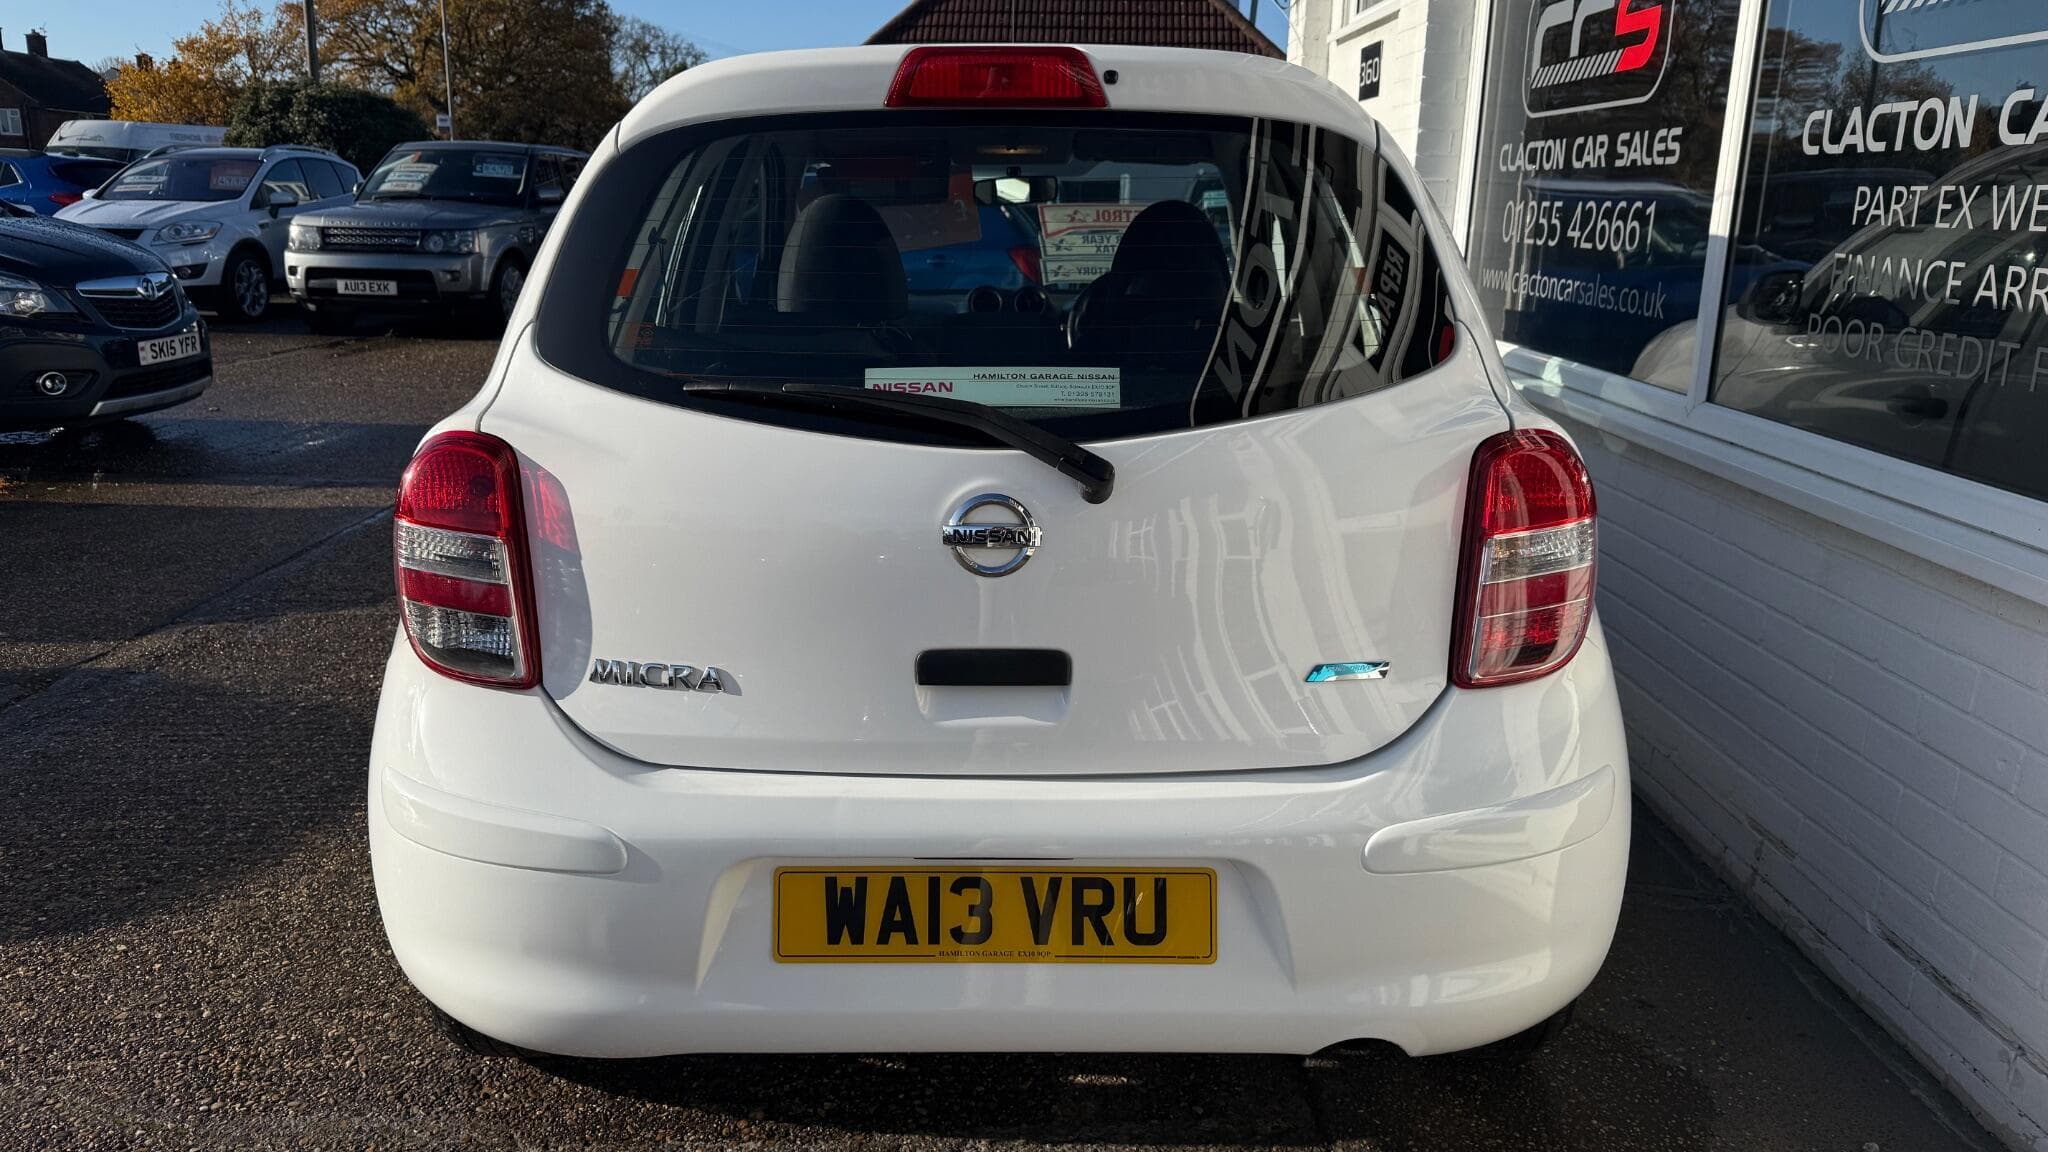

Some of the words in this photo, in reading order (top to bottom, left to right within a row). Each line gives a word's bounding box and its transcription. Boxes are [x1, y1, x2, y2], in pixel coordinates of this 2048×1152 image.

[1360, 58, 1380, 87] 360
[1802, 94, 1979, 156] CLACTON
[1500, 138, 1566, 172] CLACTON
[1571, 134, 1609, 169] CAR
[1614, 127, 1683, 167] SALES
[1852, 185, 1929, 227] PART
[1934, 184, 1981, 230] EX
[1502, 200, 1563, 247] 01255
[1566, 200, 1657, 254] 426661
[344, 281, 366, 292] AU13
[369, 281, 390, 293] EXK
[1830, 252, 1967, 306] FINANCE
[150, 340, 177, 360] SK15
[178, 335, 198, 354] YFR
[1807, 313, 1885, 363] POOR
[1894, 326, 2021, 387] CREDIT
[873, 382, 953, 393] NISSAN
[1077, 373, 1116, 381] NISSAN
[952, 527, 1032, 545] NISSAN
[589, 658, 724, 692] MICRA
[824, 876, 993, 946] WA13
[1020, 876, 1168, 946] VRU
